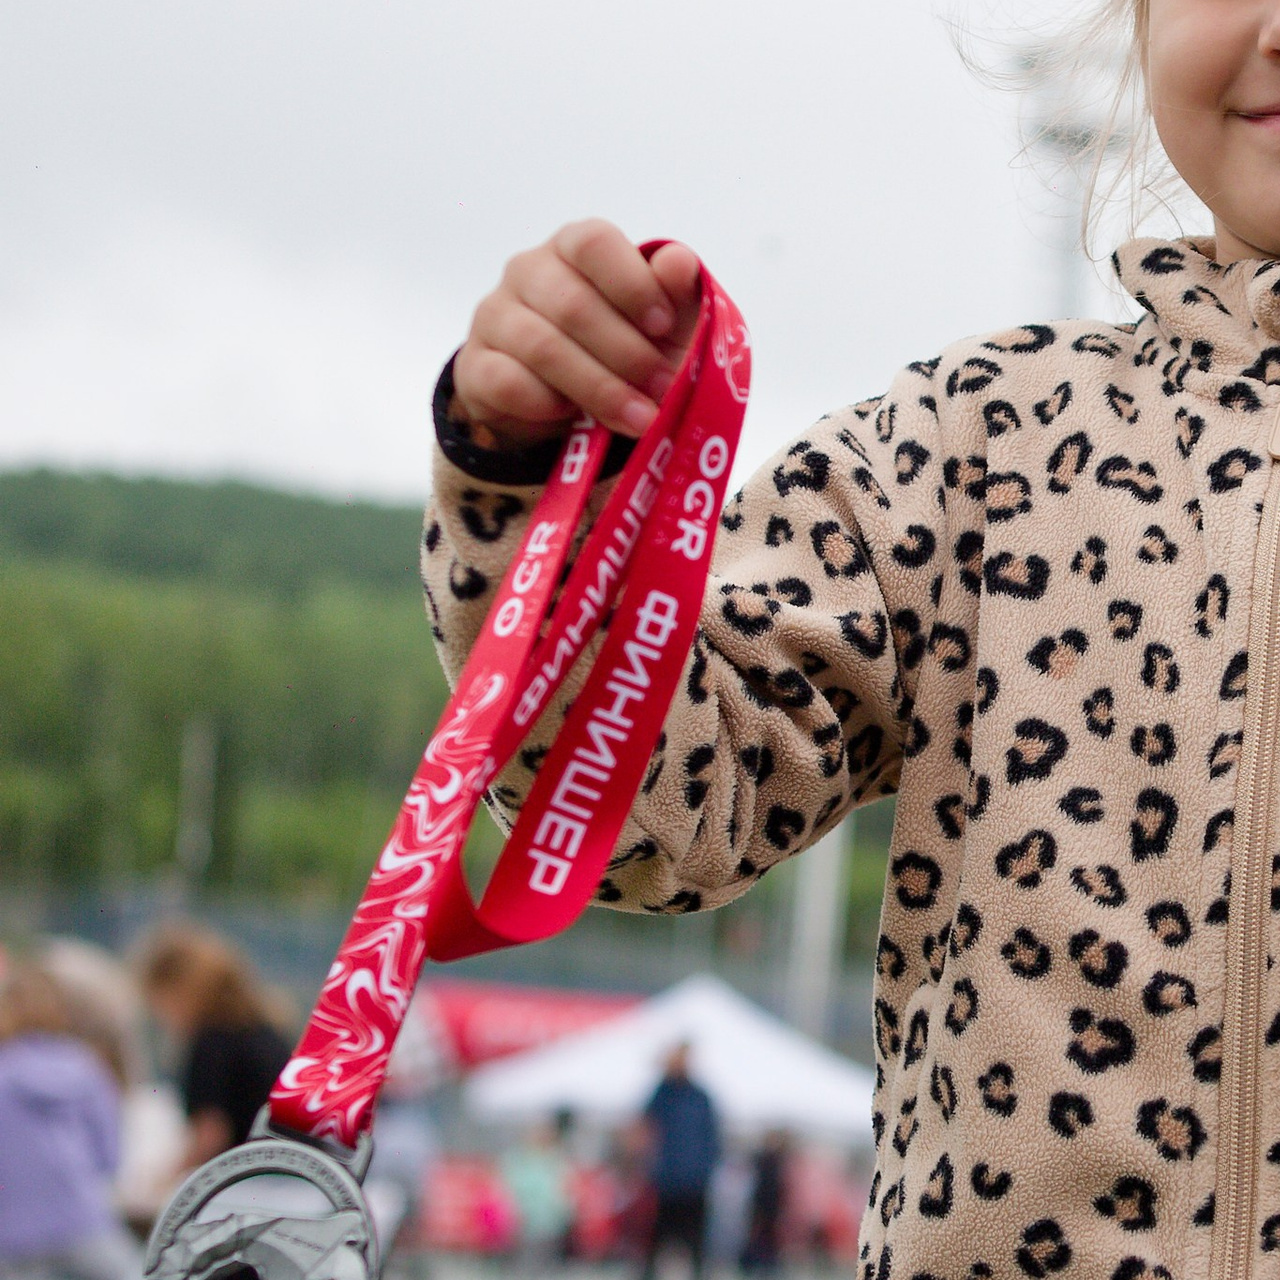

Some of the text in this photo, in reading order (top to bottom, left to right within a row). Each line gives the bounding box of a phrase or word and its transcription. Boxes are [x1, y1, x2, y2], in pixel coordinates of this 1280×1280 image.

[492, 520, 560, 639] OCR
[513, 436, 675, 727] ФИНИШЕР
[527, 434, 729, 897] OCR ФИНИШЕР
